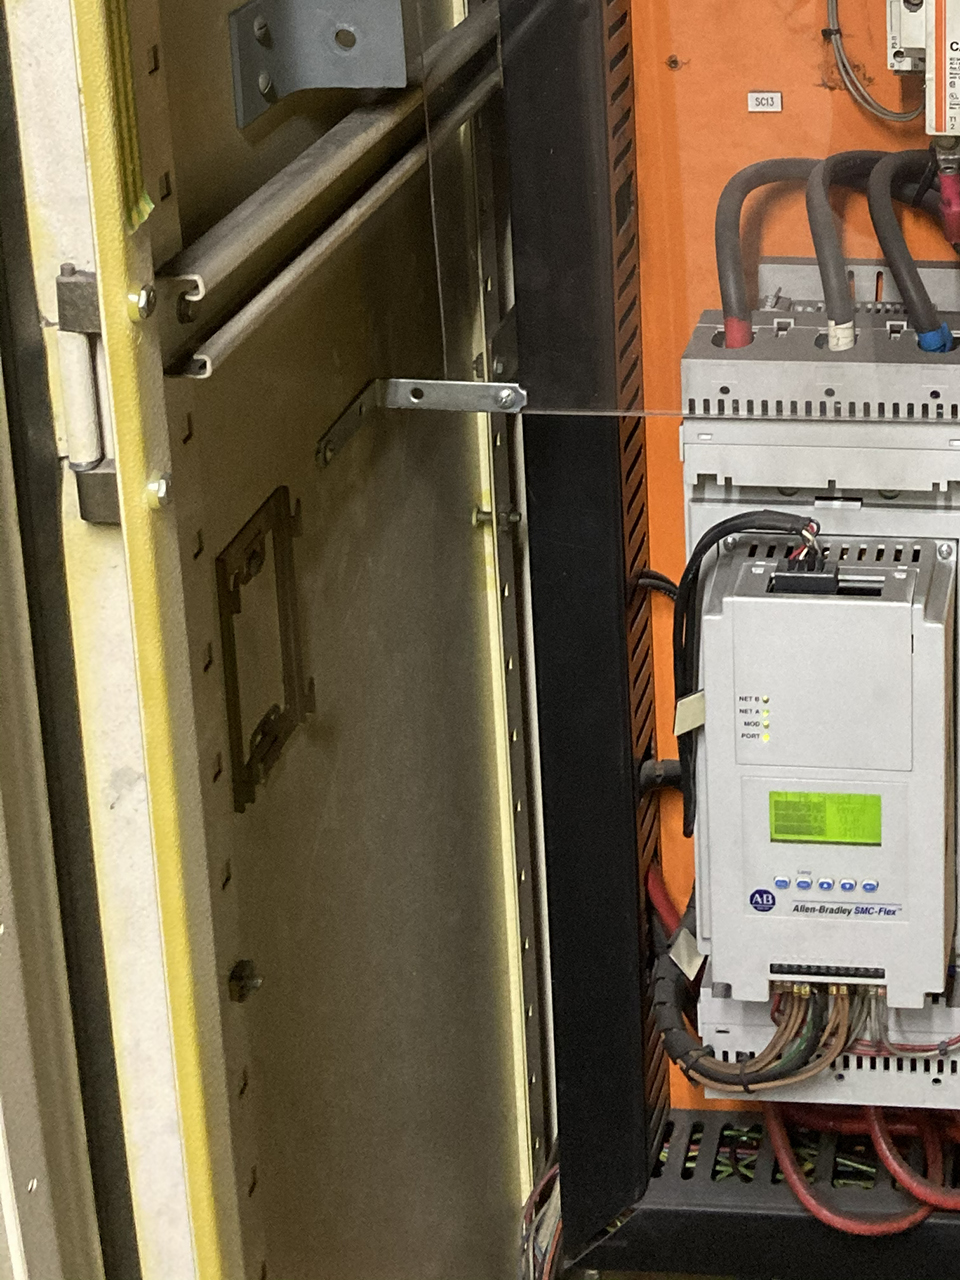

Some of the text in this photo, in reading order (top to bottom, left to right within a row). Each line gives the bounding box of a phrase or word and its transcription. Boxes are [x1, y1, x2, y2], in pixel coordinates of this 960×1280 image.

[754, 96, 774, 107] SC13
[752, 894, 773, 906] AB
[792, 904, 853, 916] Allen-Bradley
